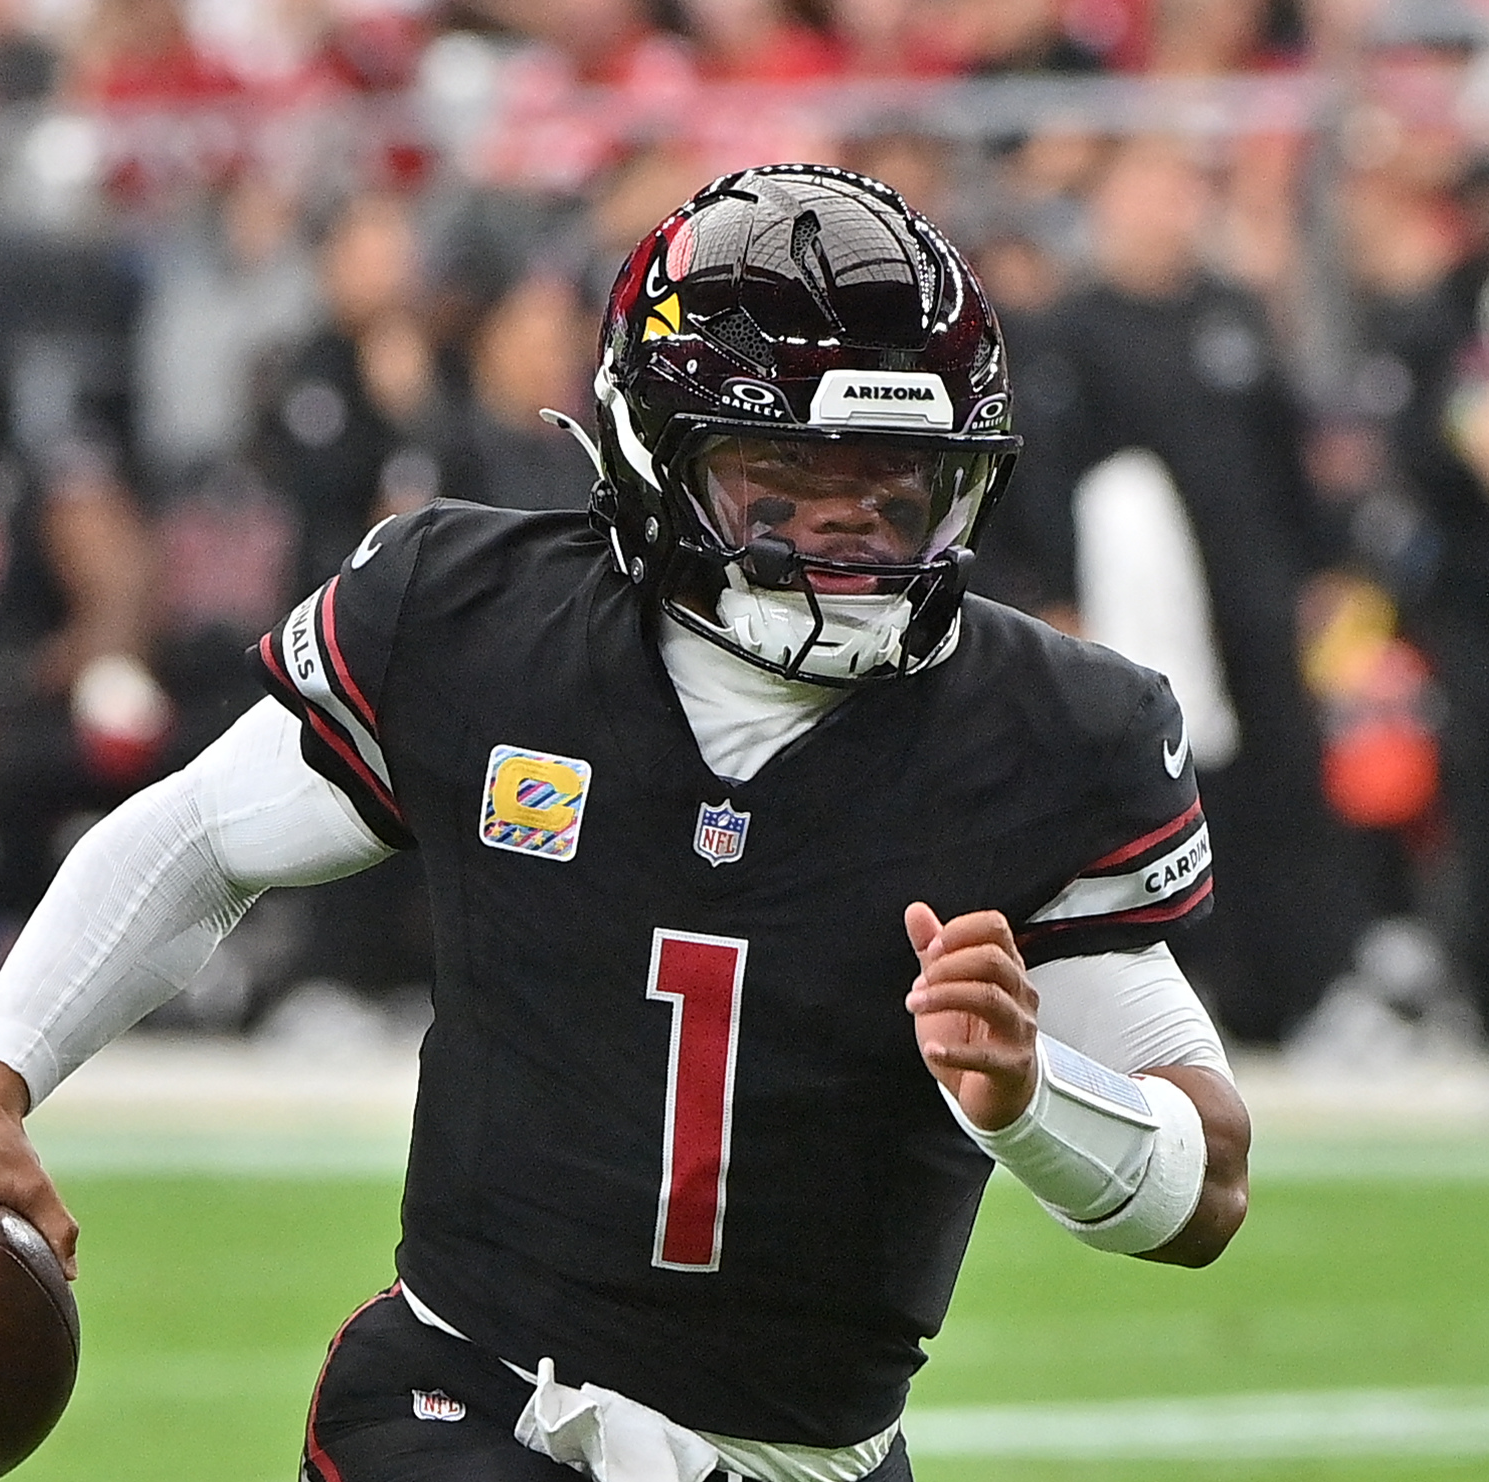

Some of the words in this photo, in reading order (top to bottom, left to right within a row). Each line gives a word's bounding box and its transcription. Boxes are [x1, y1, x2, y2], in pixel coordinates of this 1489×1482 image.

[843, 385, 935, 401] ARIZONA
[721, 395, 785, 418] OAKLEY
[492, 756, 582, 832] C
[701, 828, 736, 855] NFL
[646, 927, 749, 1273] 1
[424, 1397, 459, 1415] NFL
